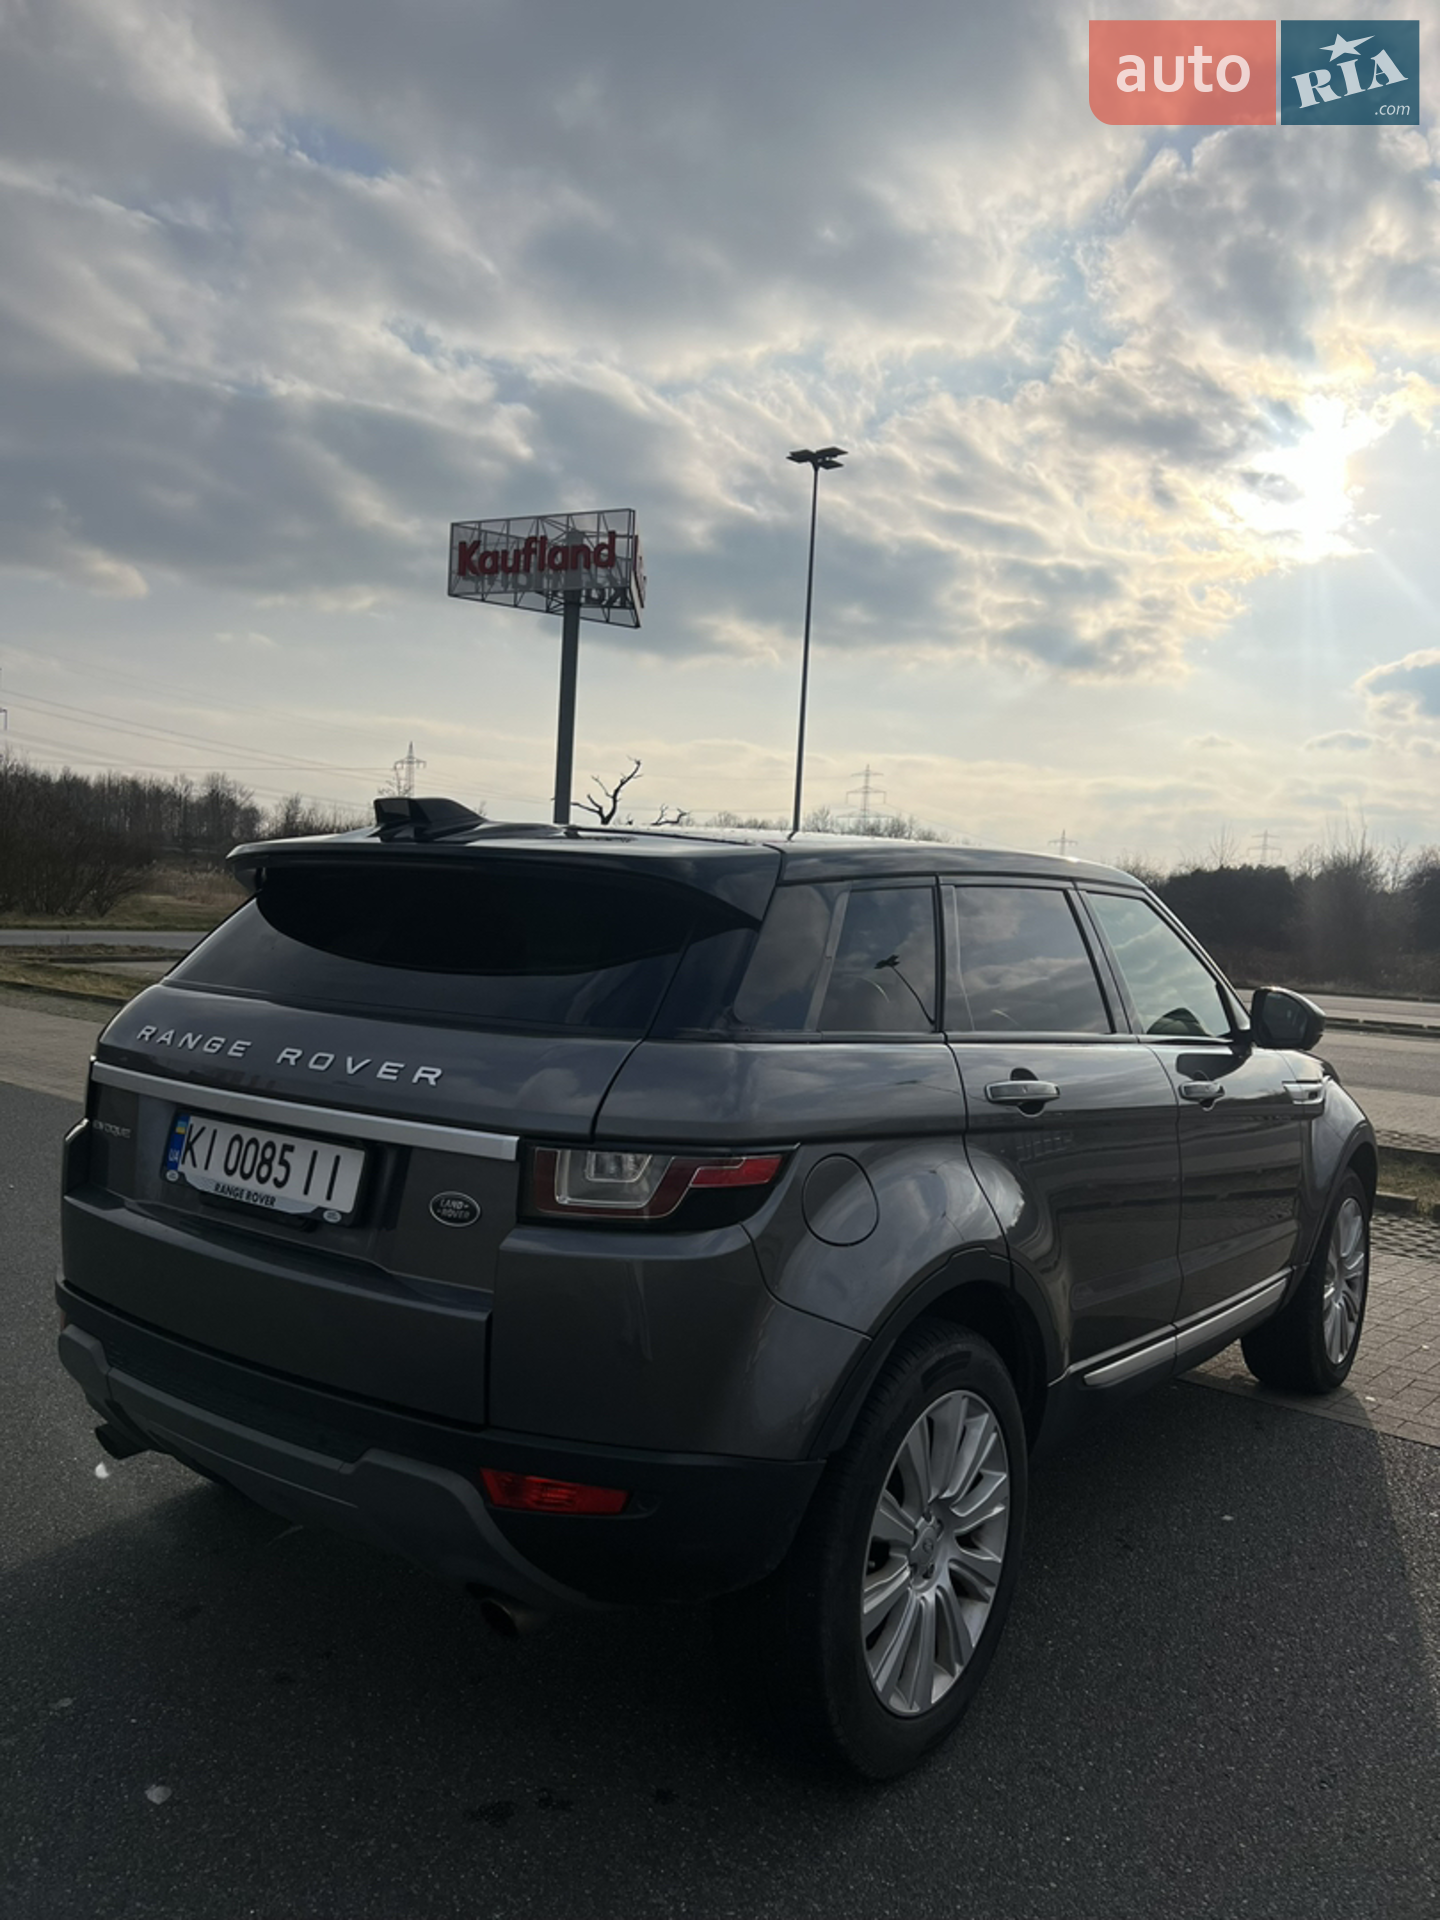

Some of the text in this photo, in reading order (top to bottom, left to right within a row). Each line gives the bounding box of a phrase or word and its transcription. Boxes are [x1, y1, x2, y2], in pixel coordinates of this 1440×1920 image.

[457, 530, 616, 577] Kaufland
[136, 1024, 444, 1087] RANGE ROVER
[181, 1123, 218, 1171] KI
[224, 1133, 296, 1188] 0085
[214, 1182, 277, 1207] RANGE ROVER
